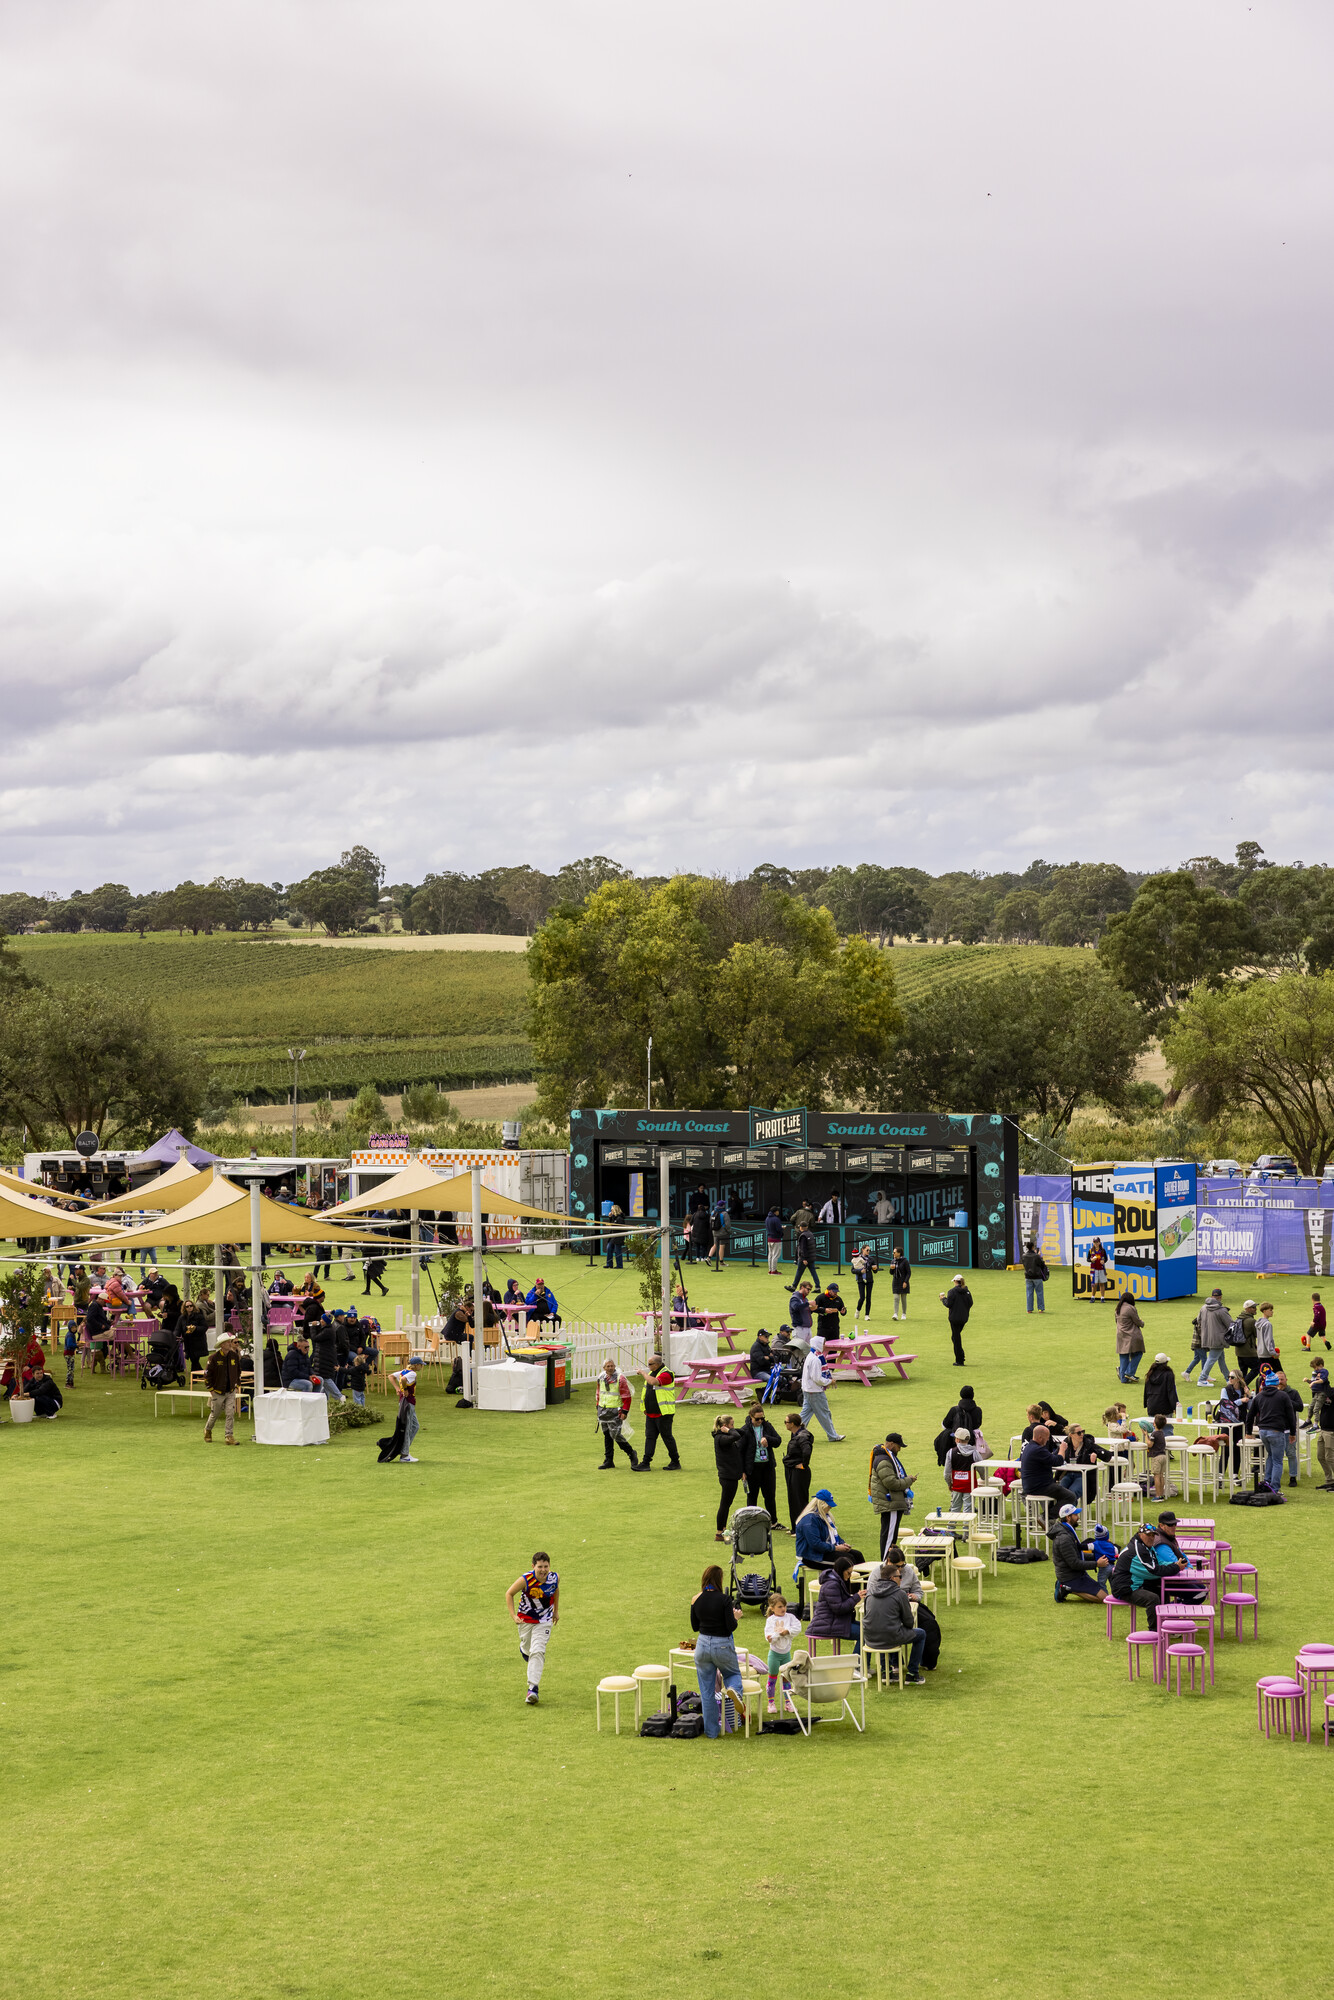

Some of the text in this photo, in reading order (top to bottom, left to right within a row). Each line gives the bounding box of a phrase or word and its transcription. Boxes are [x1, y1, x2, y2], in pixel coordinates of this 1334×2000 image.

[636, 1119, 731, 1133] South Coast
[827, 1122, 928, 1136] South Coast
[1114, 1204, 1155, 1234] ROU
[1213, 1231, 1254, 1251] ROUND
